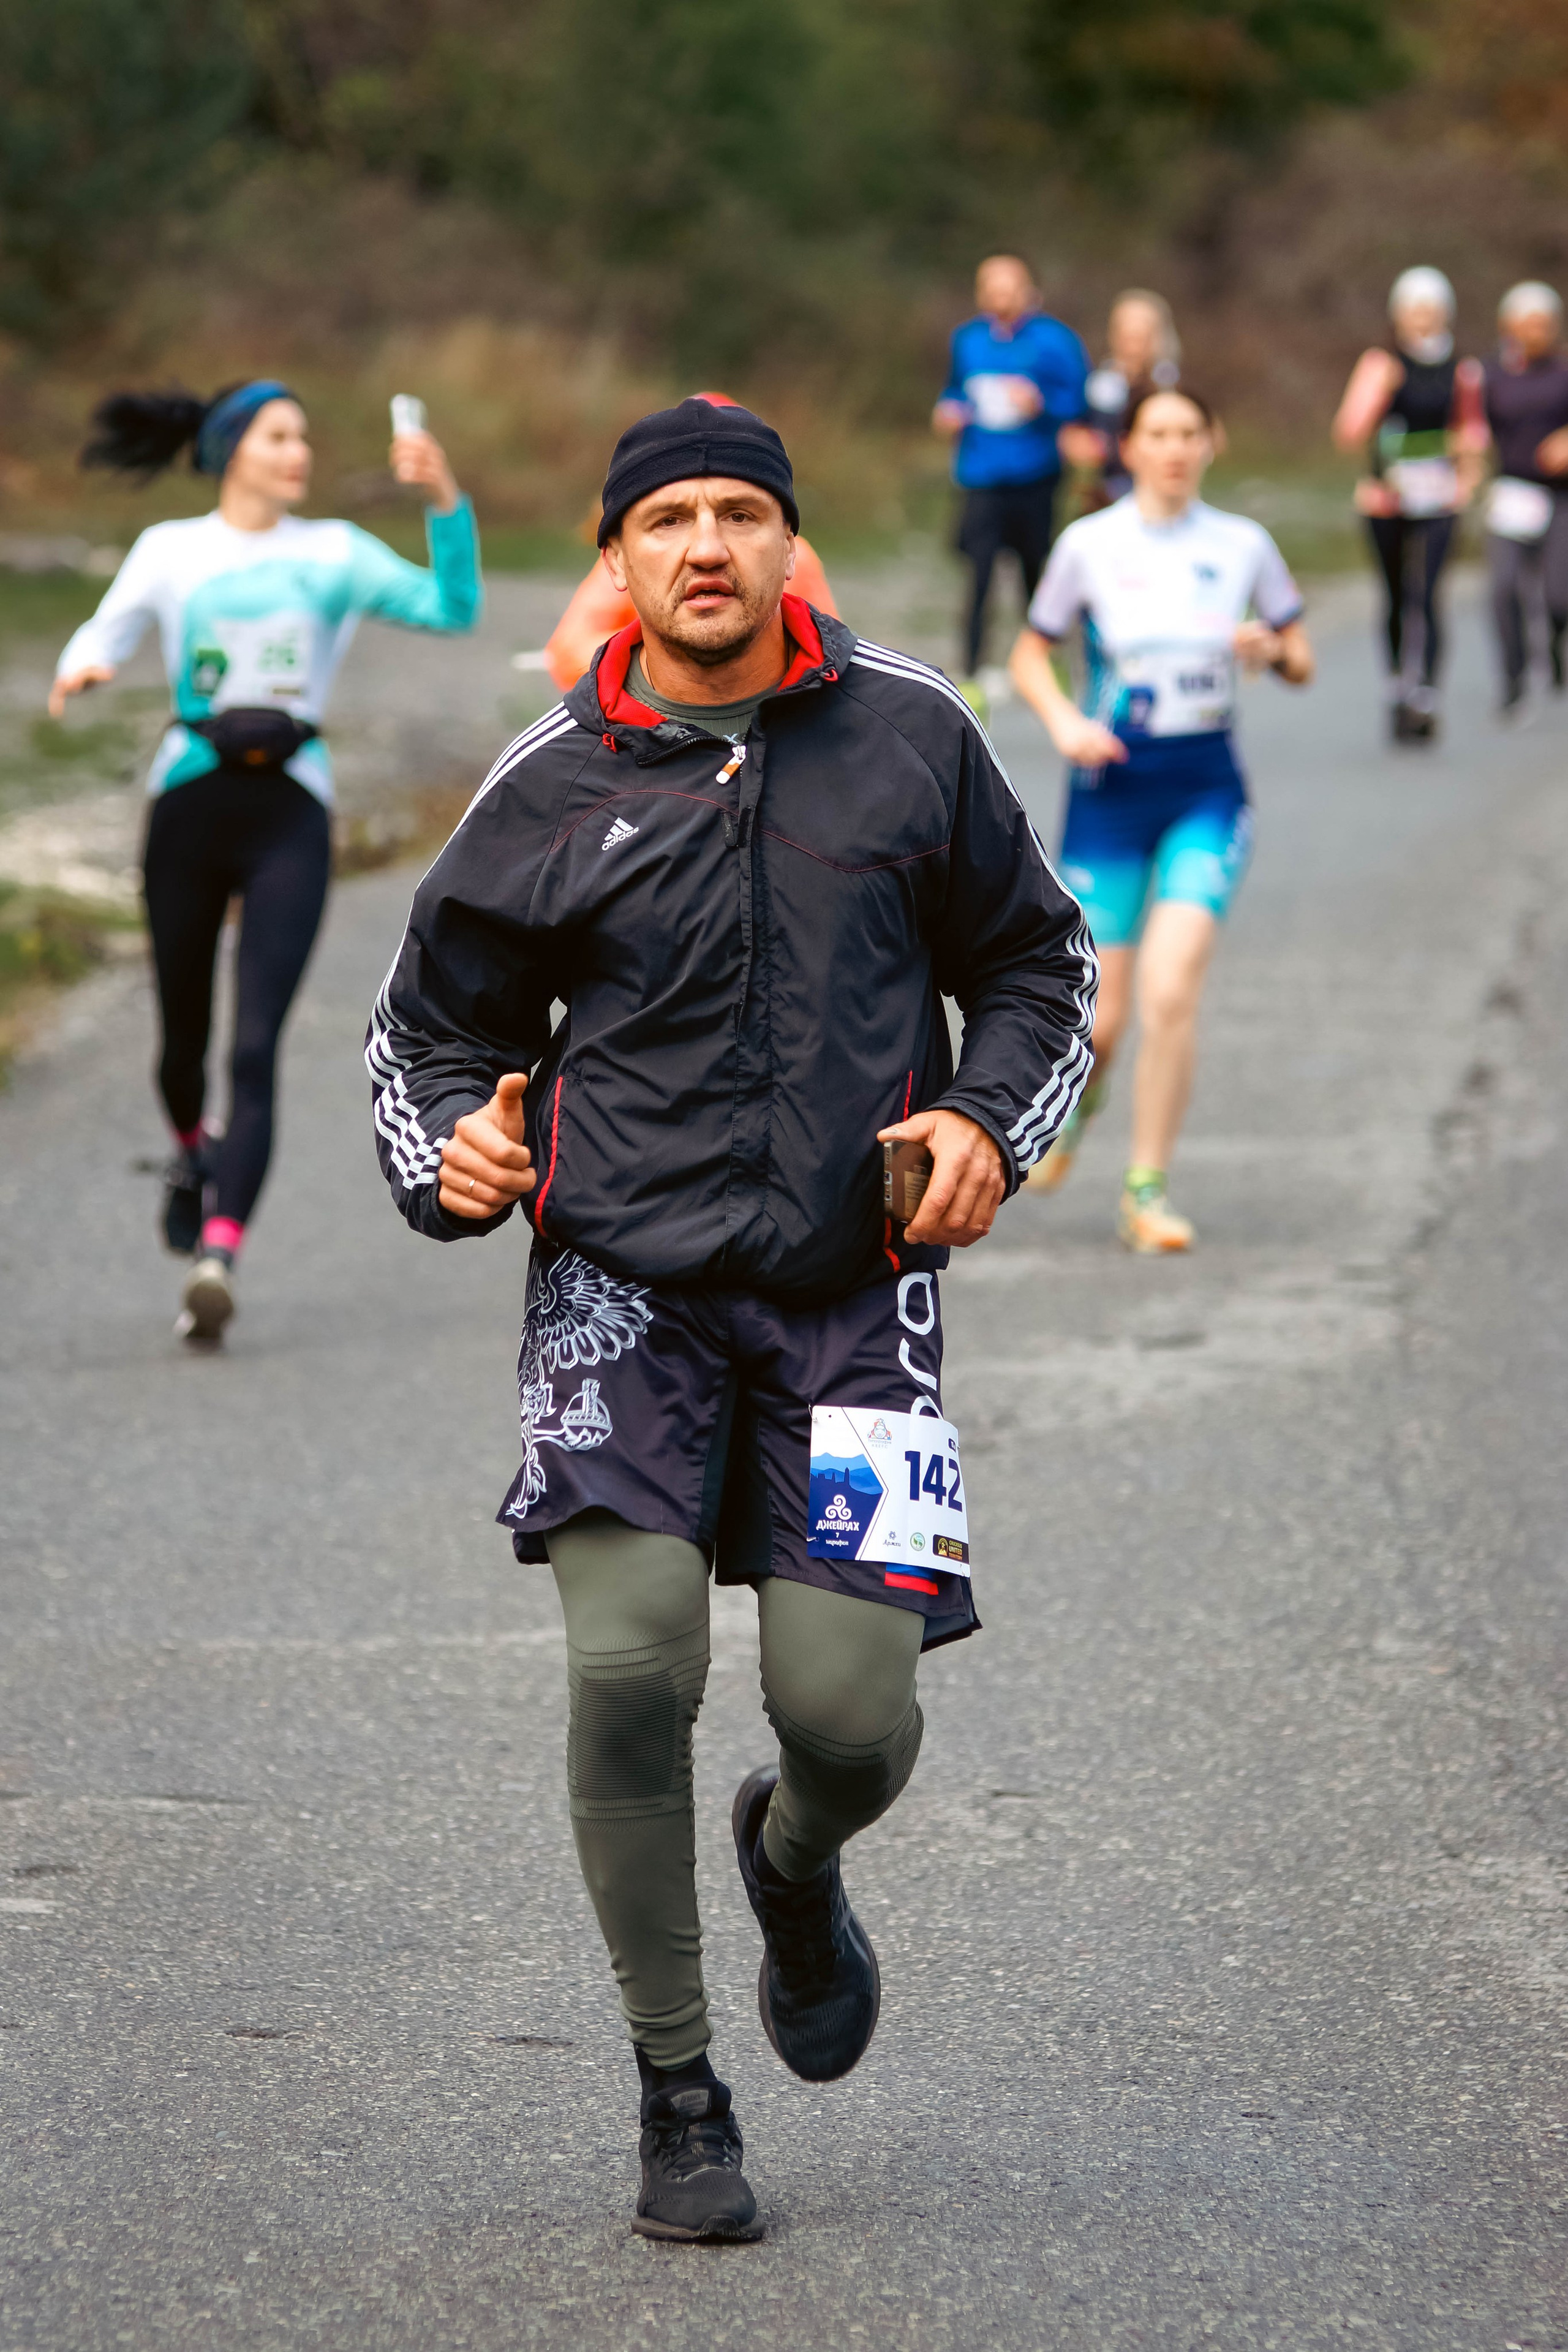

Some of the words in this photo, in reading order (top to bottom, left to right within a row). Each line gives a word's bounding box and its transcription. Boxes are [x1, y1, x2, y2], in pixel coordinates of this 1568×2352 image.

[601, 827, 639, 851] adidas
[905, 1450, 962, 1513] 142
[816, 1520, 859, 1531] ДЖЕЙРАХ
[949, 1545, 962, 1555] UNITED
